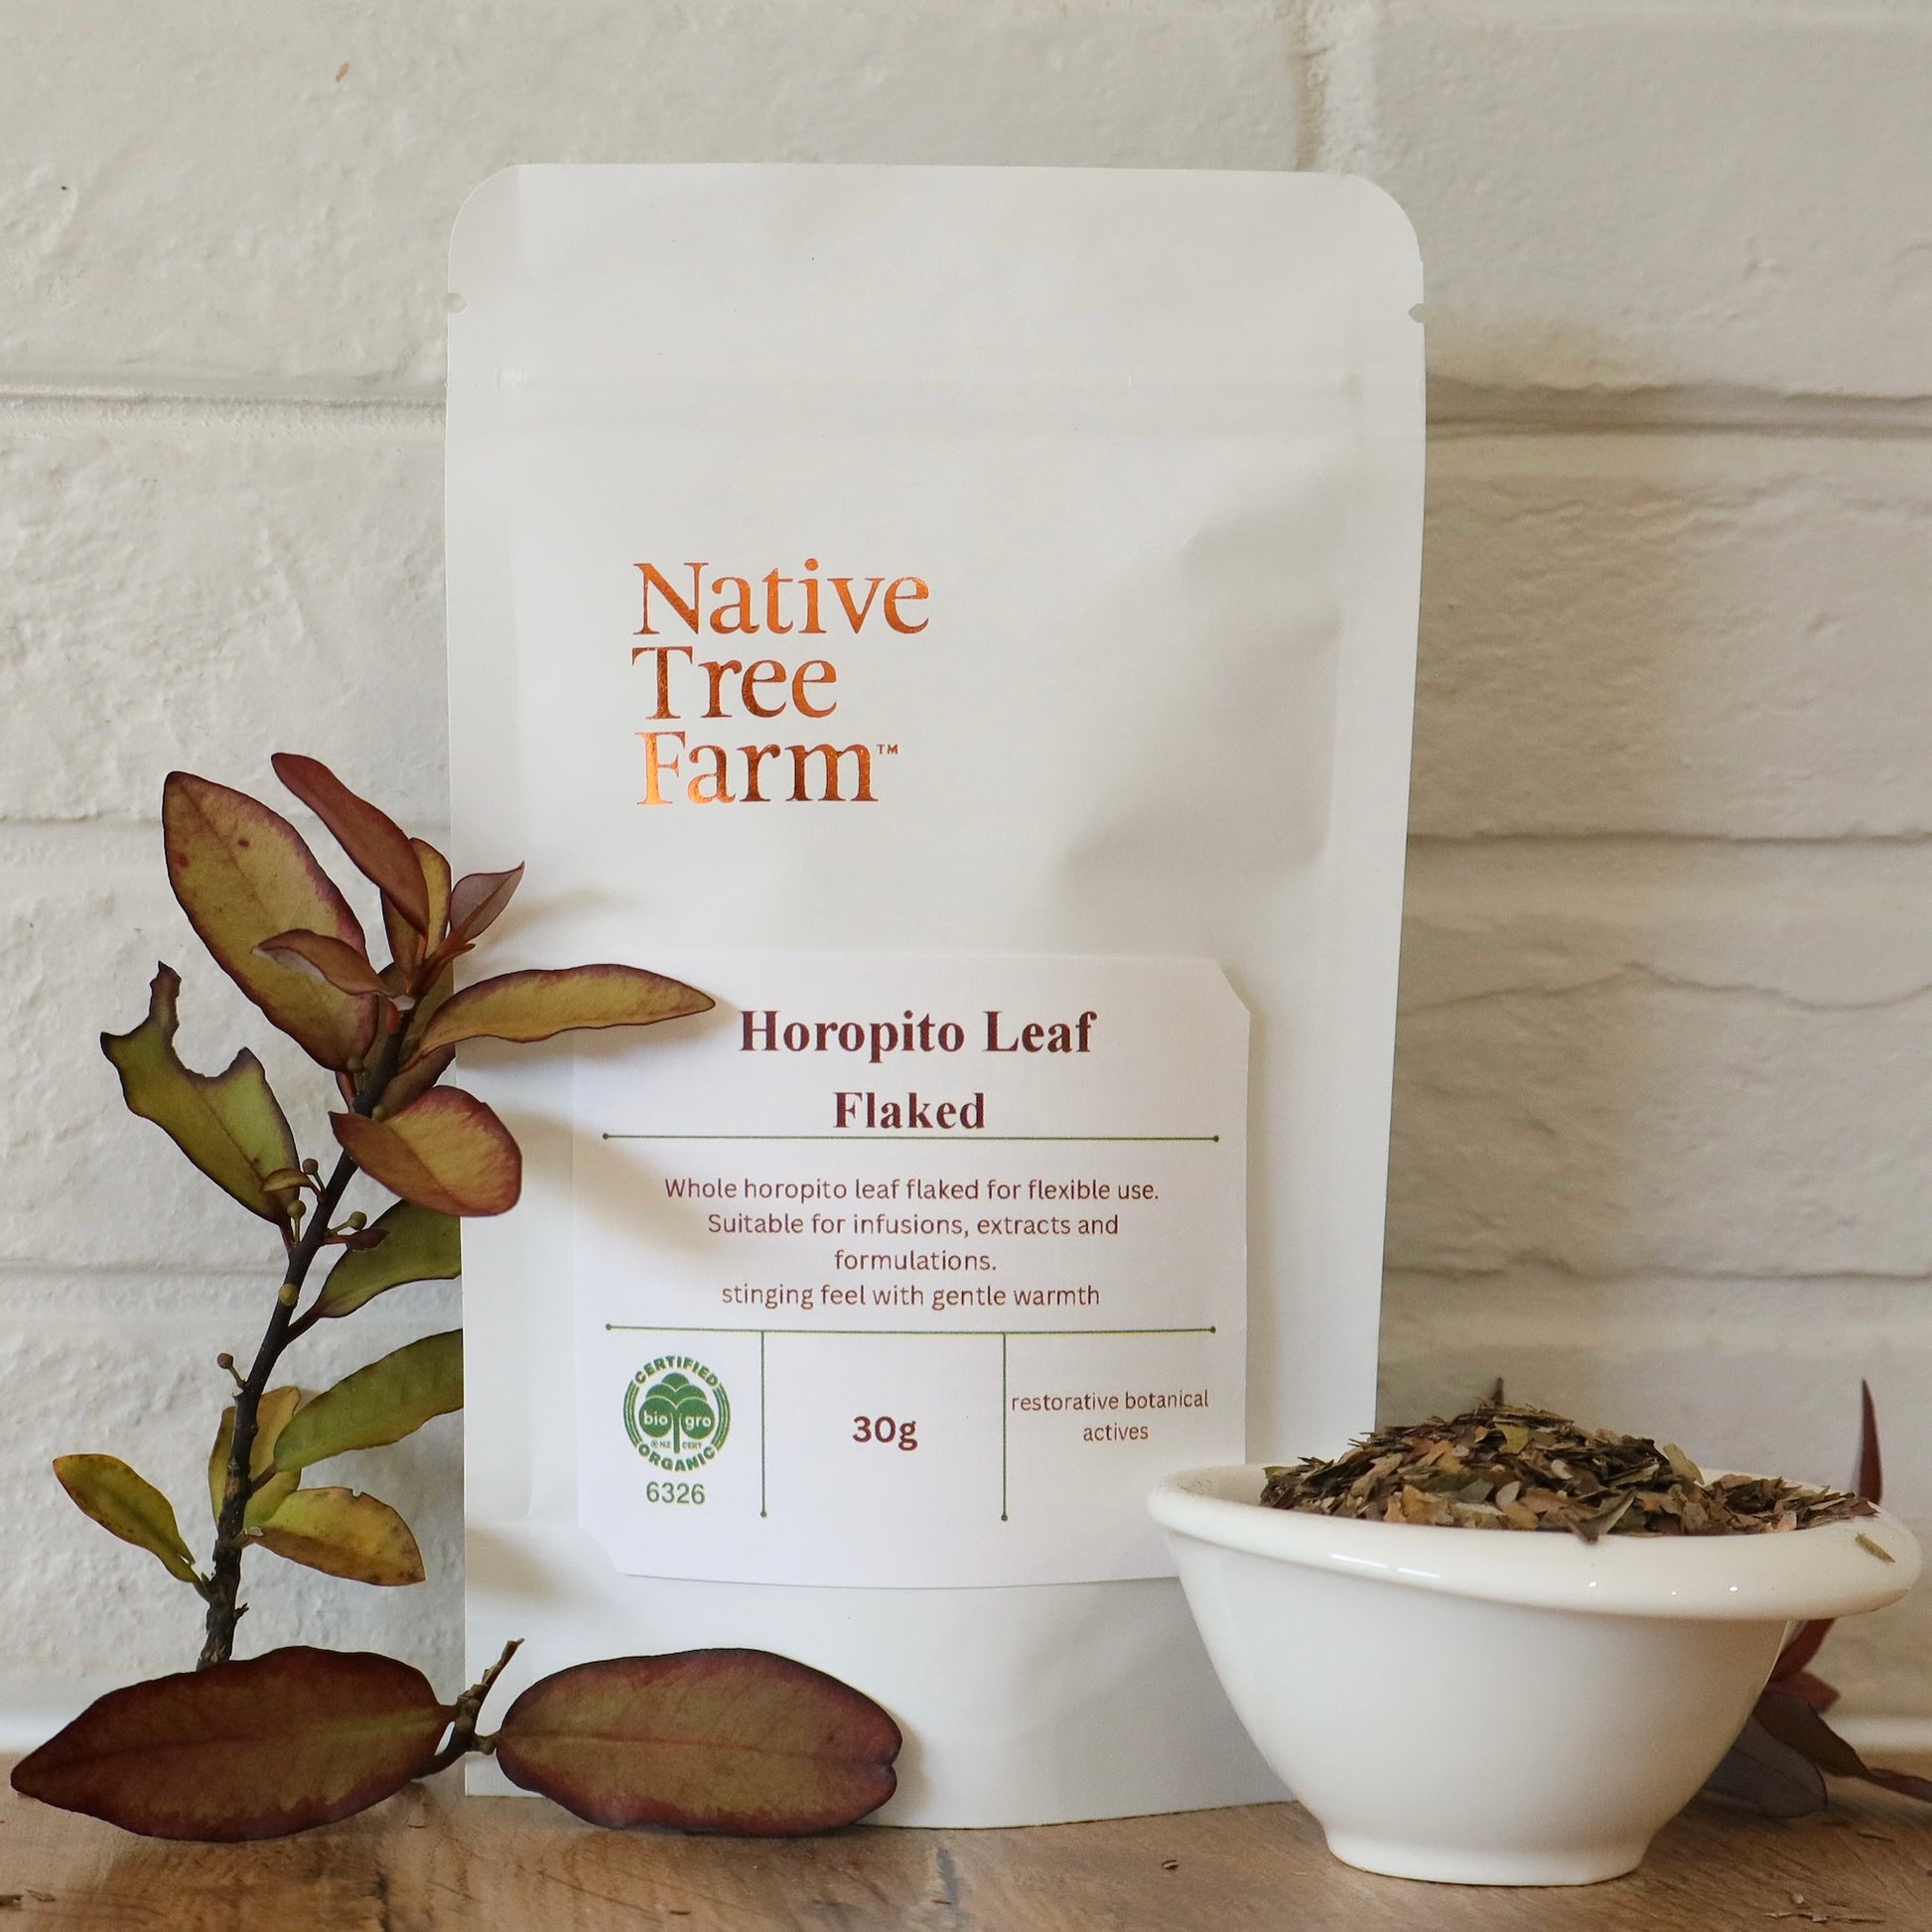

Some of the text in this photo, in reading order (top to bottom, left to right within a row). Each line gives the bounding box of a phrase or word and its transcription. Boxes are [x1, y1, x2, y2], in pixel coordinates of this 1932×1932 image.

[631, 557, 930, 635] Native
[630, 645, 838, 721] Tree
[634, 730, 880, 806] Farm
[739, 1008, 1098, 1063] Horopito Leaf
[833, 1091, 986, 1130] Flaked
[664, 1177, 1160, 1205] Whole horopito leaf flaked for flexible use.
[707, 1212, 1119, 1239] Suitable for infusions, extracts and
[833, 1248, 997, 1272] formulations.
[722, 1283, 1100, 1311] stinging feel with gentle warmth
[634, 1355, 720, 1388] CERTIFIED
[1012, 1388, 1209, 1412] restorative botanical
[643, 1411, 712, 1431] bio gro
[852, 1415, 919, 1452] 30g
[1082, 1422, 1150, 1443] actives
[638, 1444, 716, 1471] ORGANIC
[645, 1480, 706, 1505] 6326
